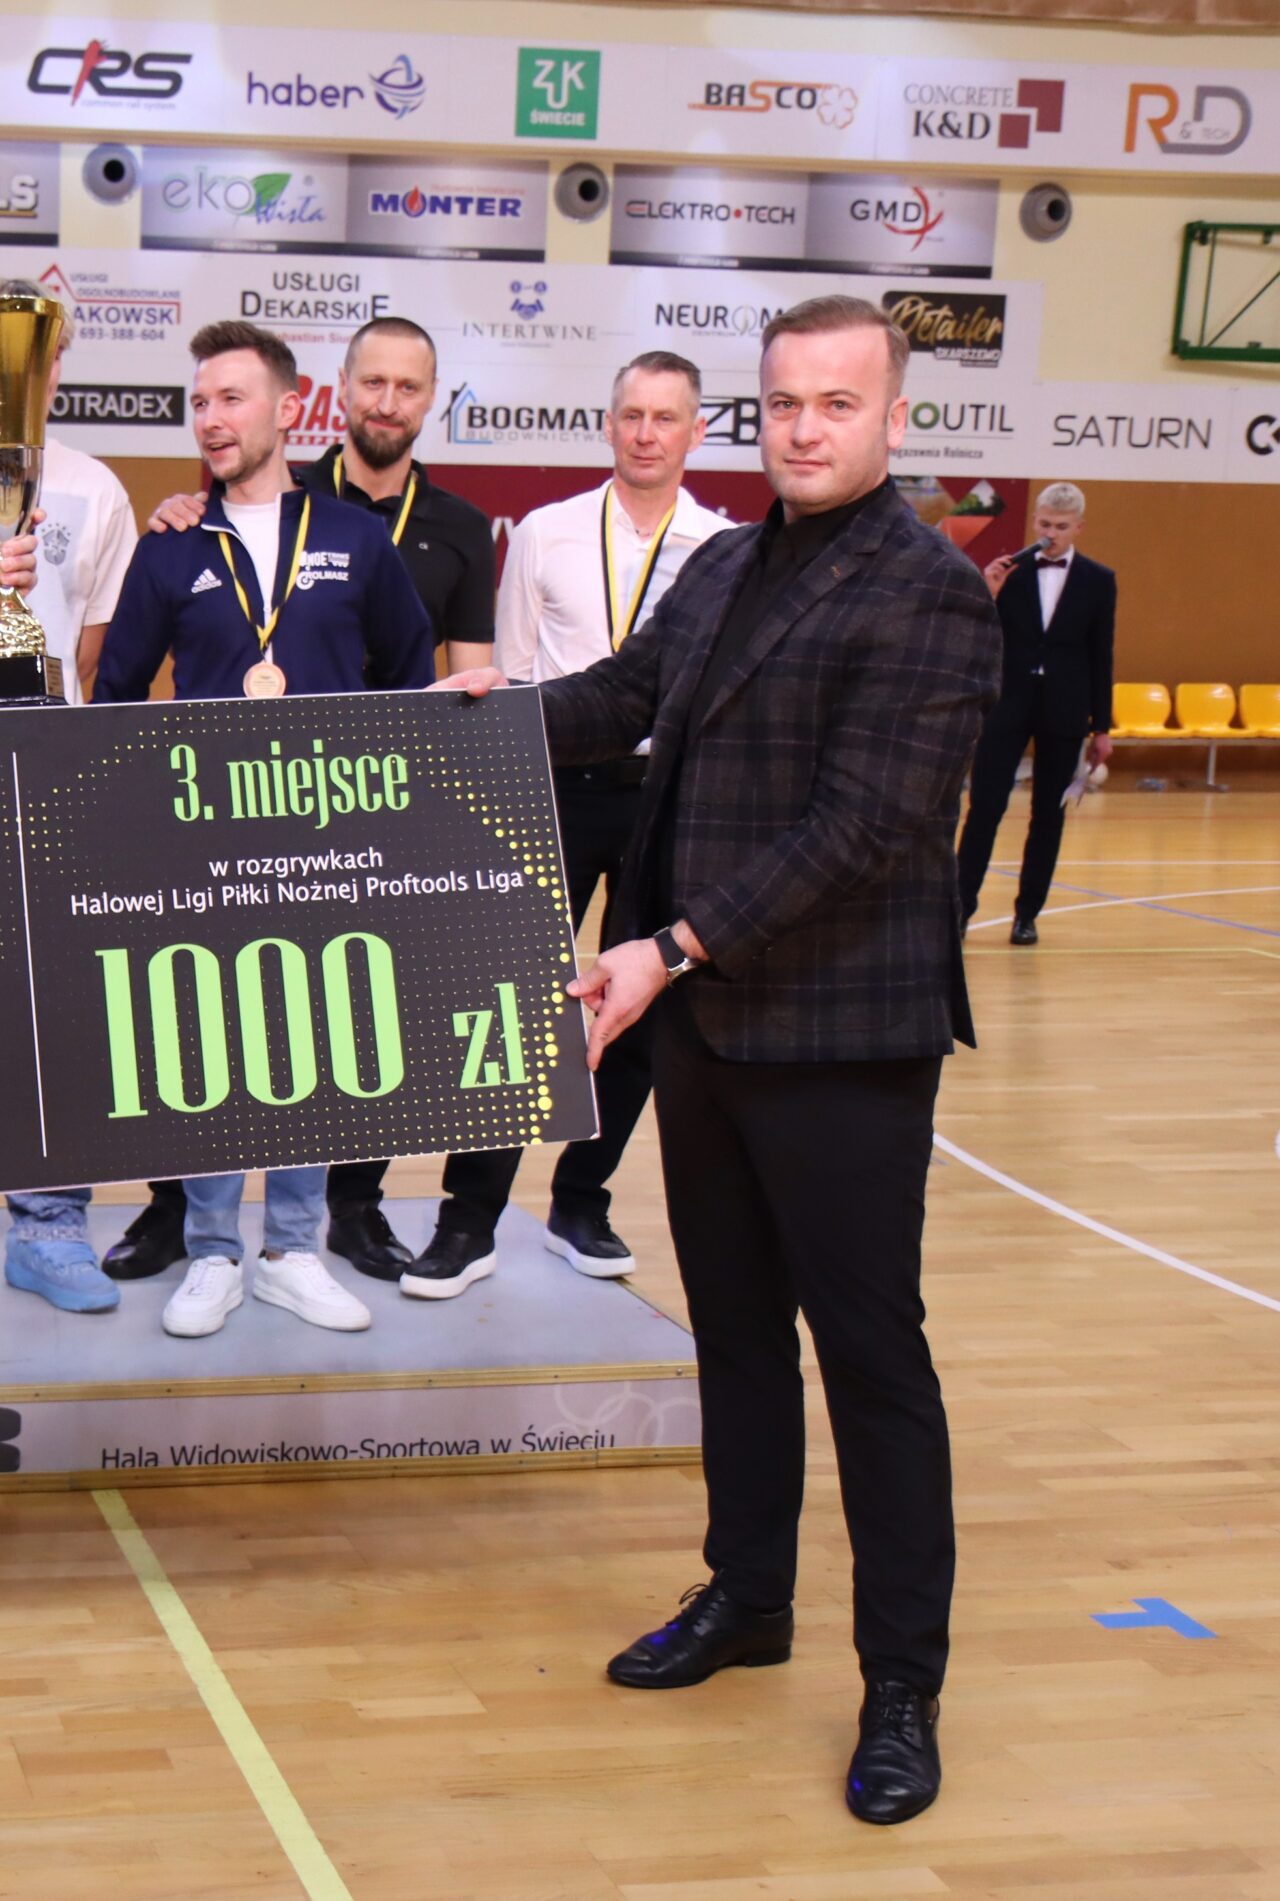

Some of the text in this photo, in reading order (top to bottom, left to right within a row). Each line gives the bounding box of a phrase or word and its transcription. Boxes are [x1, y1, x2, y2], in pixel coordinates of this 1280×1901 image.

[27, 47, 193, 99] CRS
[247, 71, 365, 109] haber
[704, 81, 818, 112] BASCO
[903, 83, 1015, 108] CONCRETE
[912, 110, 992, 140] K&D
[162, 168, 253, 212] eko
[371, 190, 522, 218] MONTER
[849, 199, 924, 223] GMD
[273, 272, 360, 292] USŁUGI
[241, 291, 389, 320] DEKARSKIE
[463, 323, 597, 341] INTERTWINE
[1052, 415, 1212, 449] SATURN
[170, 740, 410, 829] 3. miejsce
[209, 846, 383, 880] w rozgrywkach
[71, 868, 523, 915] Halowej Ligi Piłki Nożnej Proftools Liga
[94, 931, 531, 1119] 1000 zł
[101, 1446, 159, 1470] Hala
[170, 1437, 480, 1467] Widowiskowo-Sportowa
[491, 1437, 512, 1454] w
